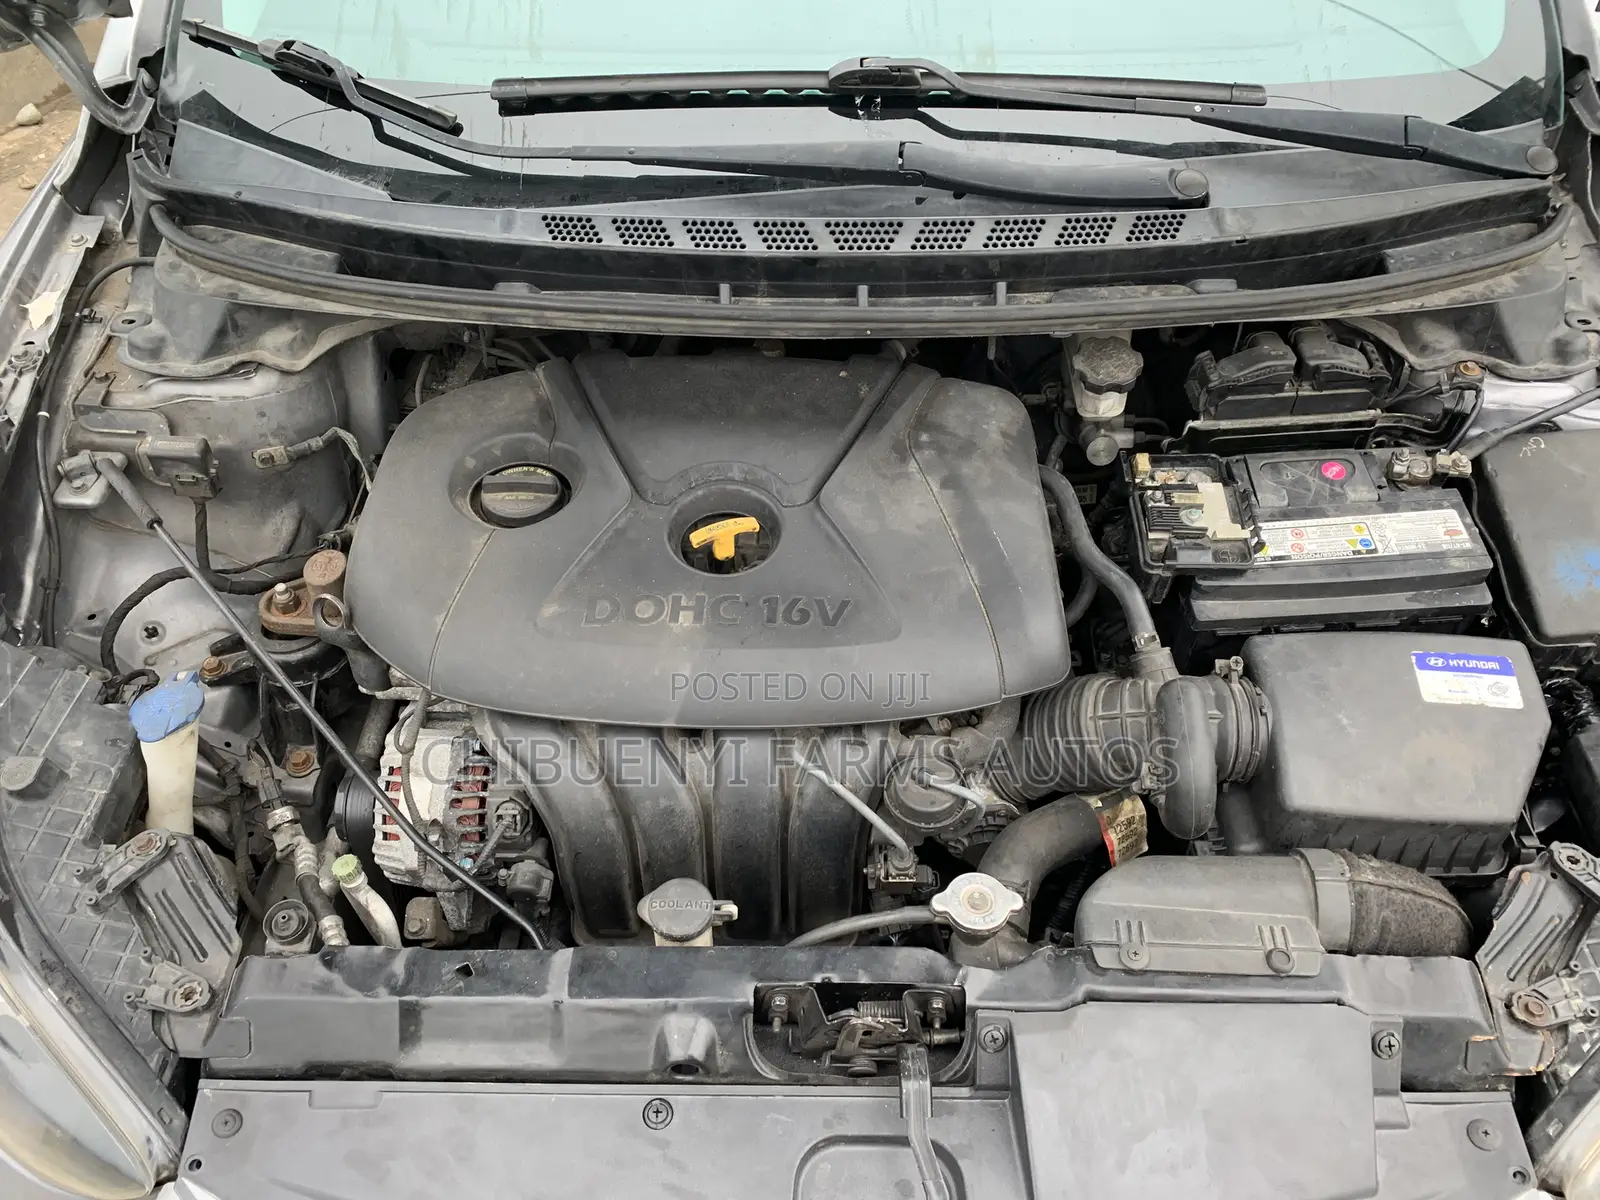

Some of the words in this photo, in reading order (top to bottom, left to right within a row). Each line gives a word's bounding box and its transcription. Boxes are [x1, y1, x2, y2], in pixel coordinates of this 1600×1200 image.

[582, 594, 743, 627] DOHC
[760, 595, 852, 627] 16V
[1449, 659, 1499, 669] HYUNDAI
[650, 899, 712, 911] COOLANT
